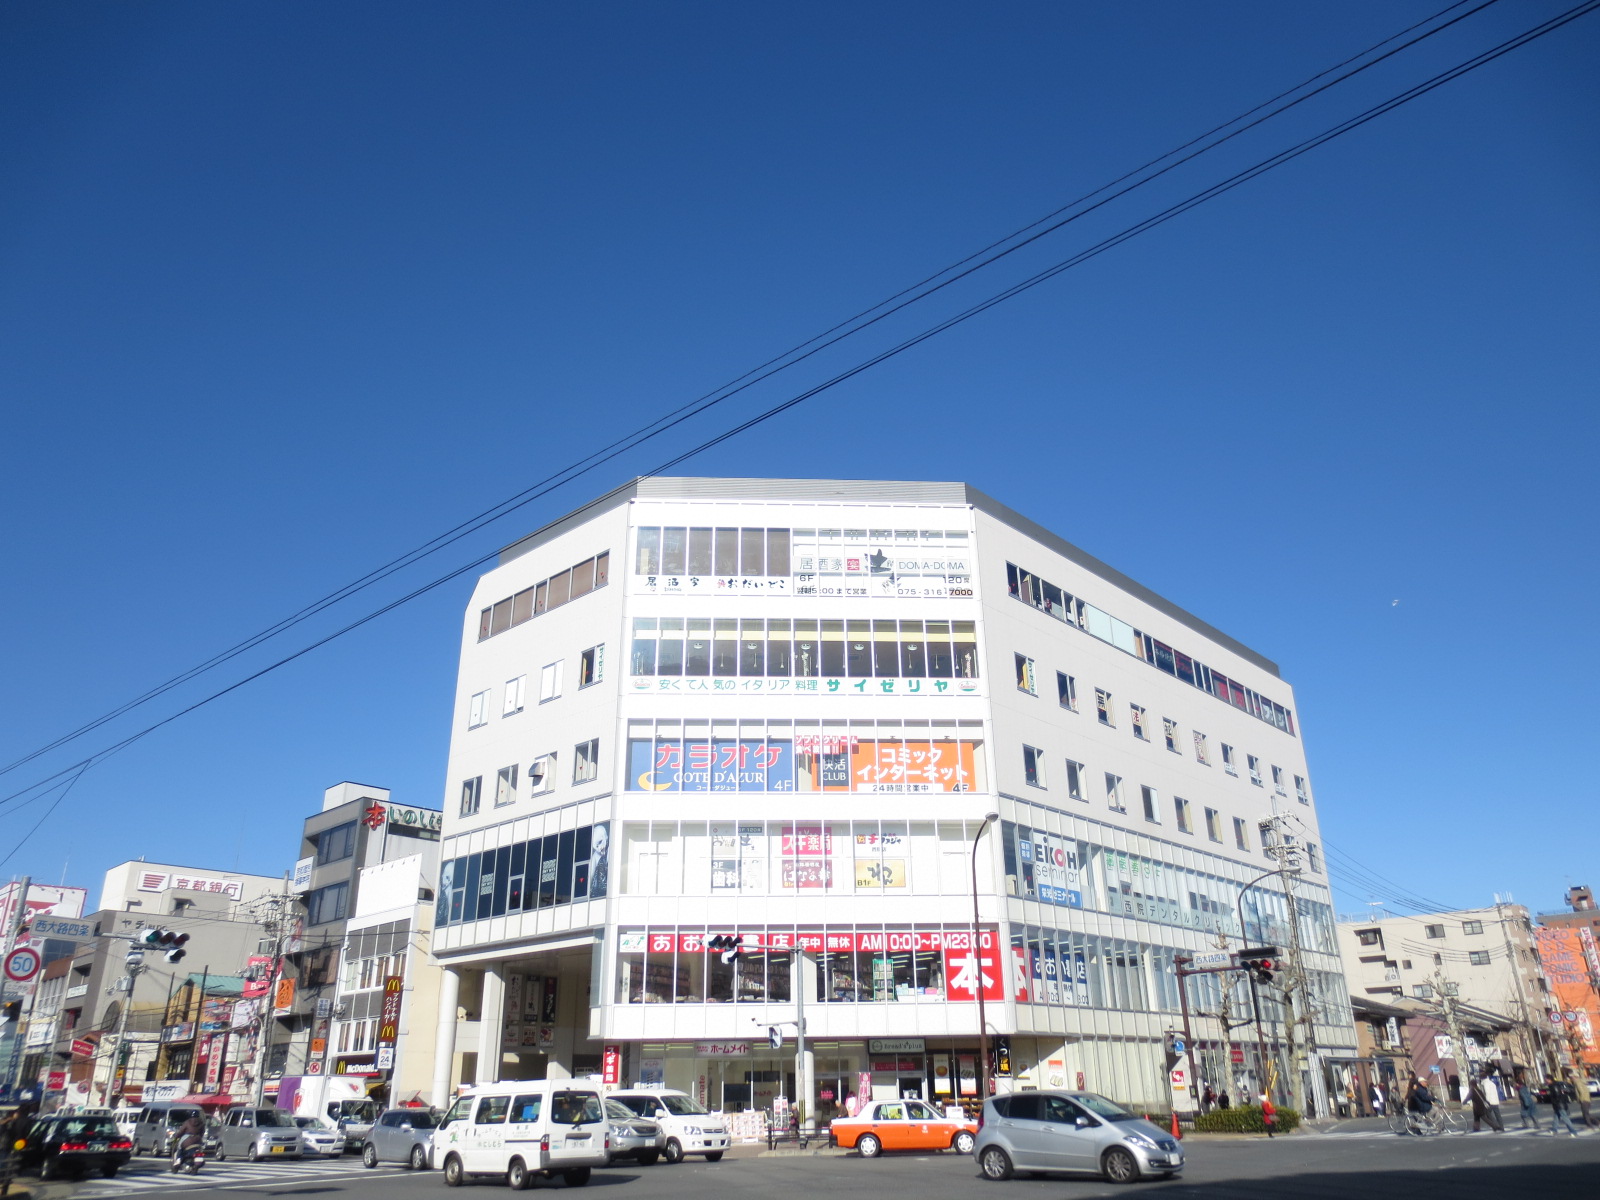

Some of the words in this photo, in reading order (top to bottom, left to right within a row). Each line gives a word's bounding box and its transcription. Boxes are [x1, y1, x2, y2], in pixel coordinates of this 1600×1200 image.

[827, 679, 948, 692] サイゼリヤ
[656, 744, 782, 769] カラオケ
[881, 747, 942, 764] コミック
[822, 771, 847, 781] CLUB
[857, 764, 968, 782] インターネット
[774, 780, 793, 791] 4F
[952, 782, 969, 792] 4F
[712, 861, 724, 869] 3F
[35, 919, 90, 937] 西大路四条
[12, 957, 34, 973] 50
[949, 952, 995, 995] 本
[710, 1044, 749, 1054] ホームメイト
[604, 1046, 615, 1082] スギ薬局
